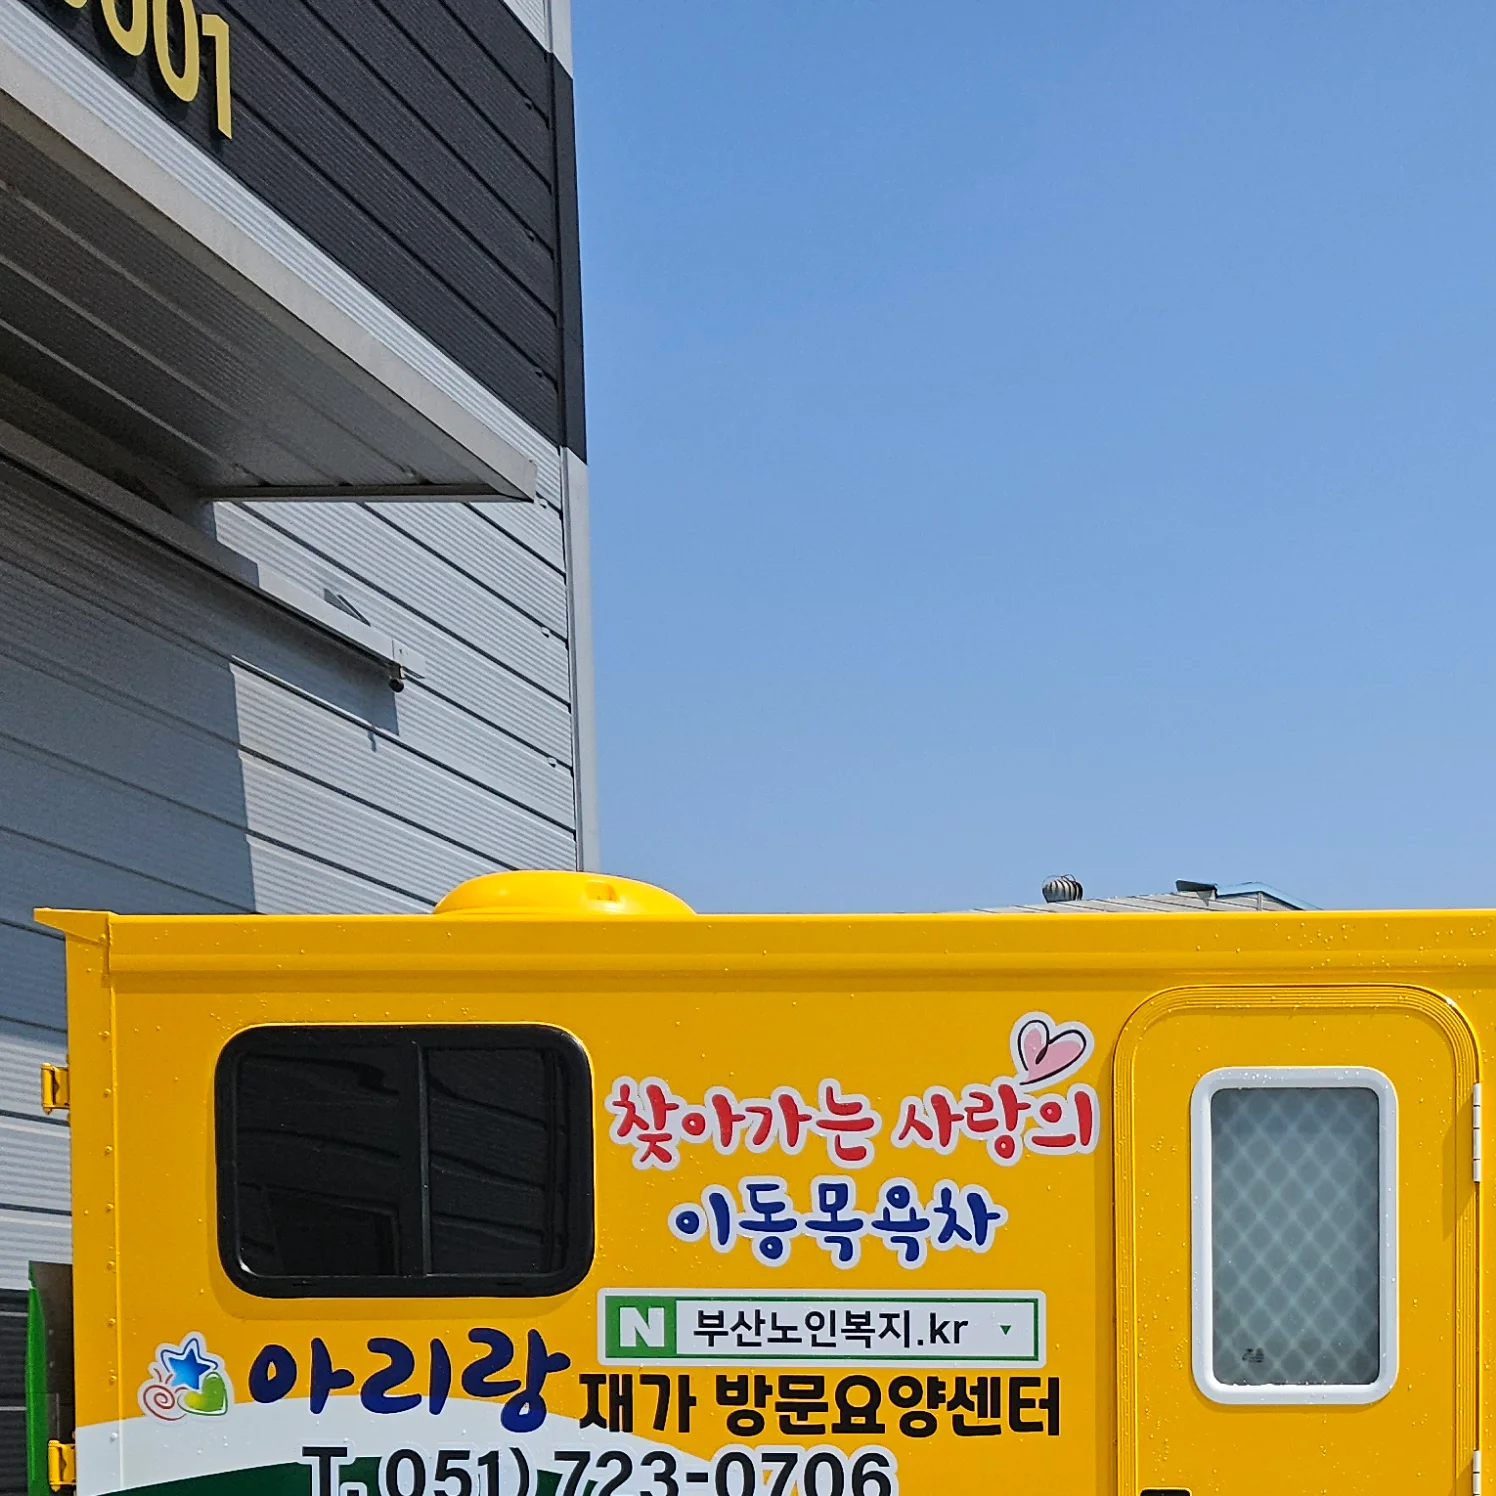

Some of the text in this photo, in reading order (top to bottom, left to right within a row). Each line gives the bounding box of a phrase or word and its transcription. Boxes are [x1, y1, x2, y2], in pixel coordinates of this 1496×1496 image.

[611, 1083, 1094, 1164] 찾아가는 사랑의
[675, 1182, 1001, 1263] 이동목욕차
[619, 1306, 969, 1348] N 부산노인복지.kr
[248, 1327, 1061, 1438] 아리랑 재가 방문요양센터
